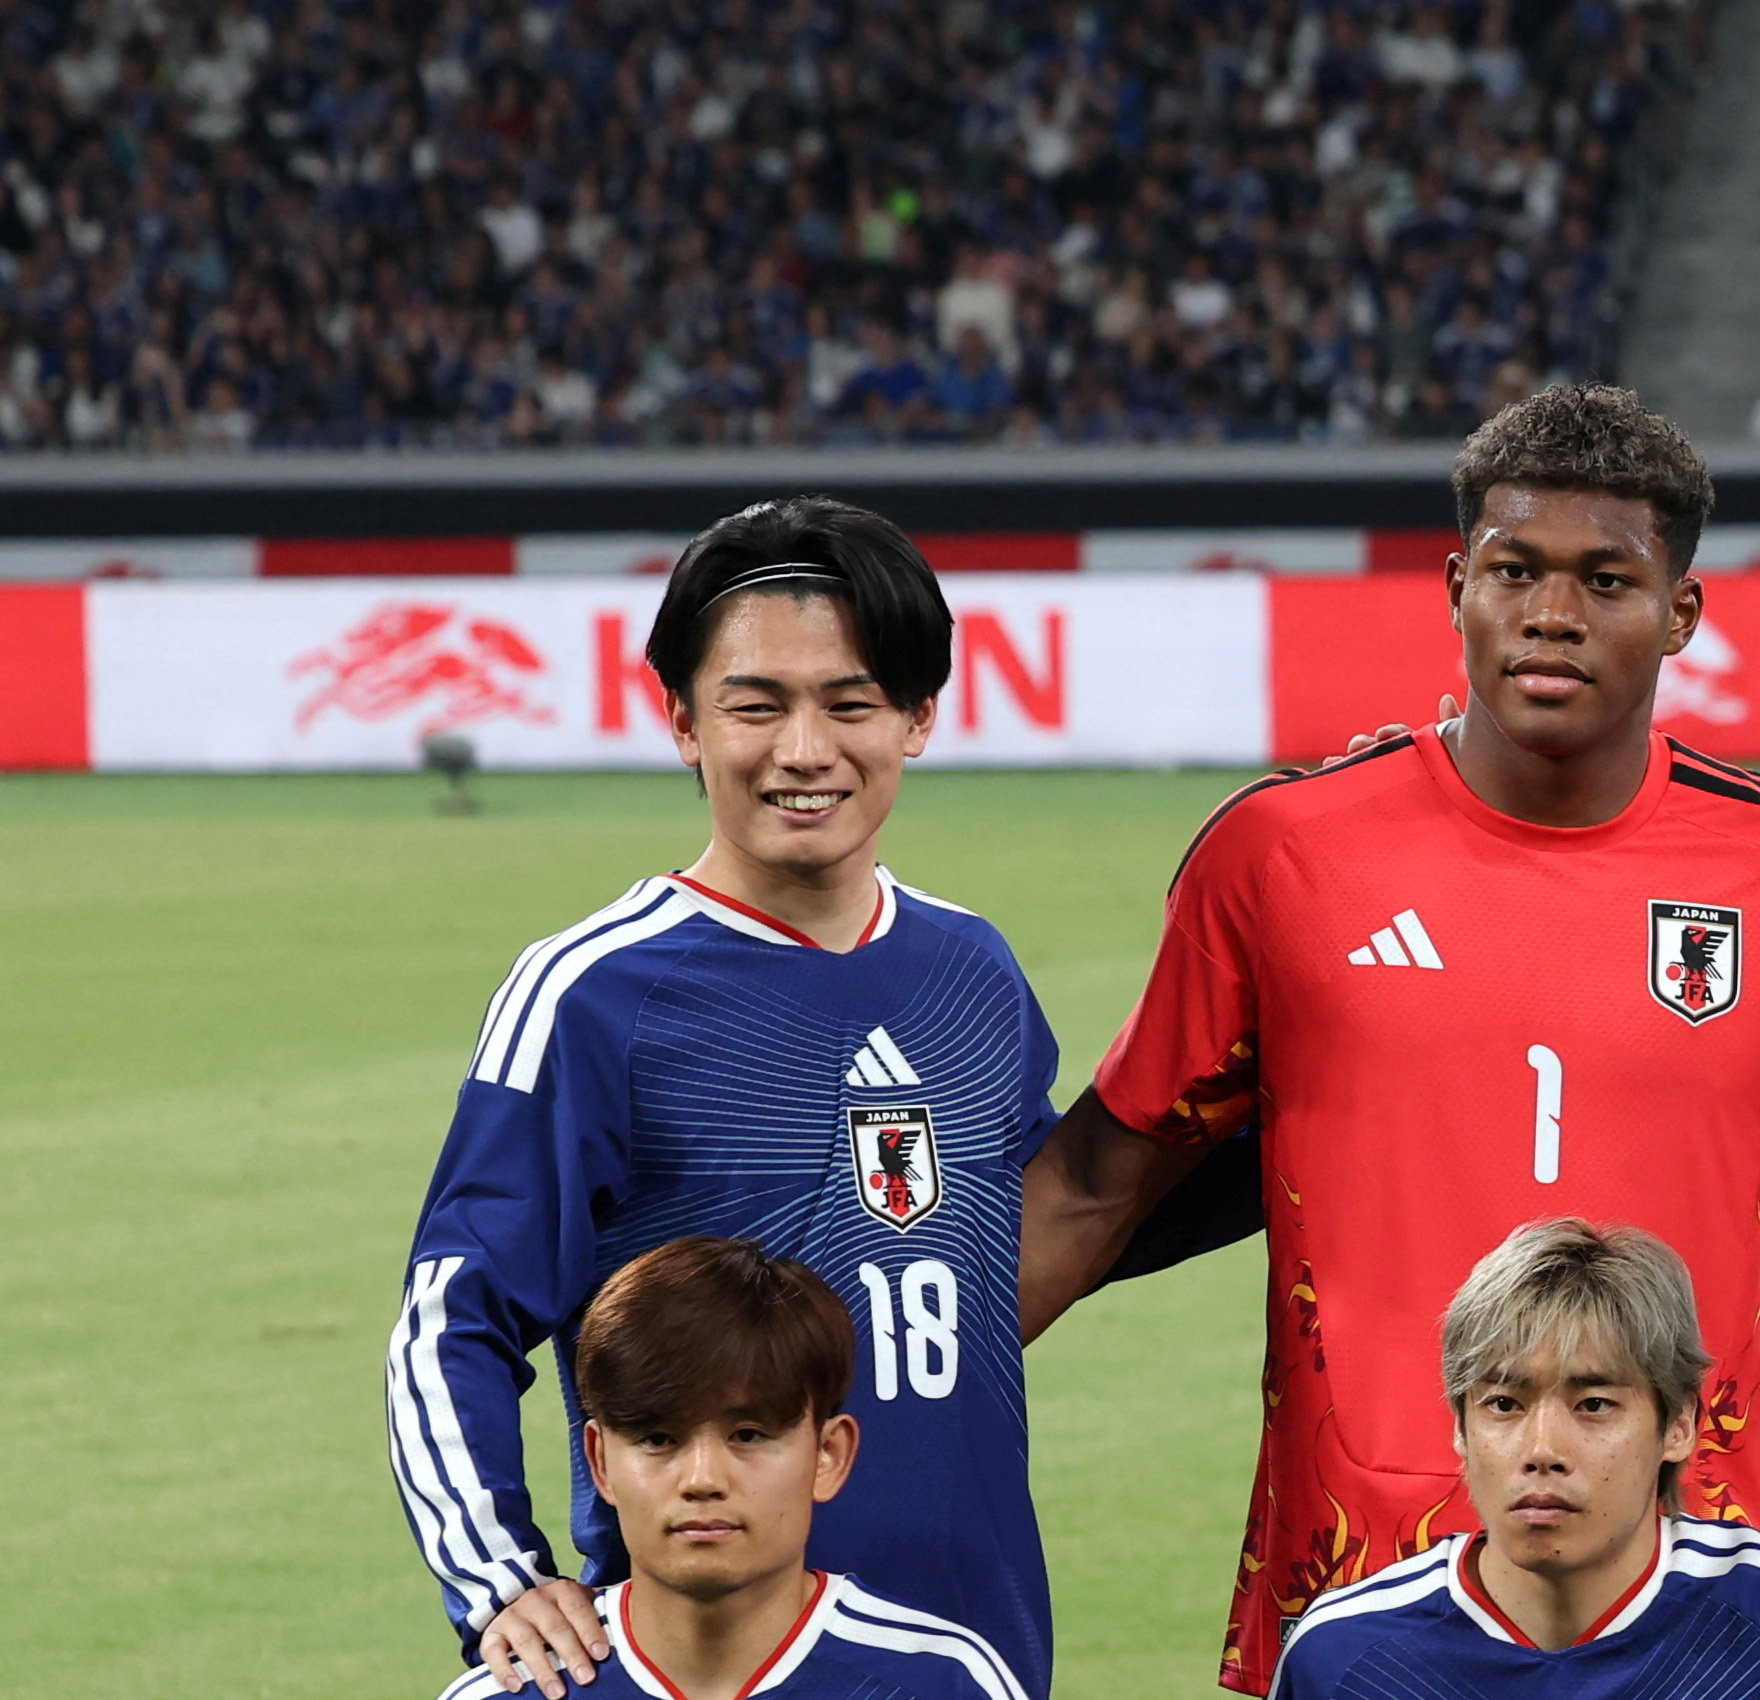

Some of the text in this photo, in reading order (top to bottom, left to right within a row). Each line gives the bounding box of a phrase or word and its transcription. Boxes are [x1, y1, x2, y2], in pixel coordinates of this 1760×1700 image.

[1672, 907, 1719, 921] JAPAN
[1675, 983, 1714, 1004] JFA
[865, 1111, 909, 1123] JAPAN
[1527, 1043, 1563, 1184] 1
[881, 1189, 918, 1209] JFA
[859, 1260, 959, 1401] 18
